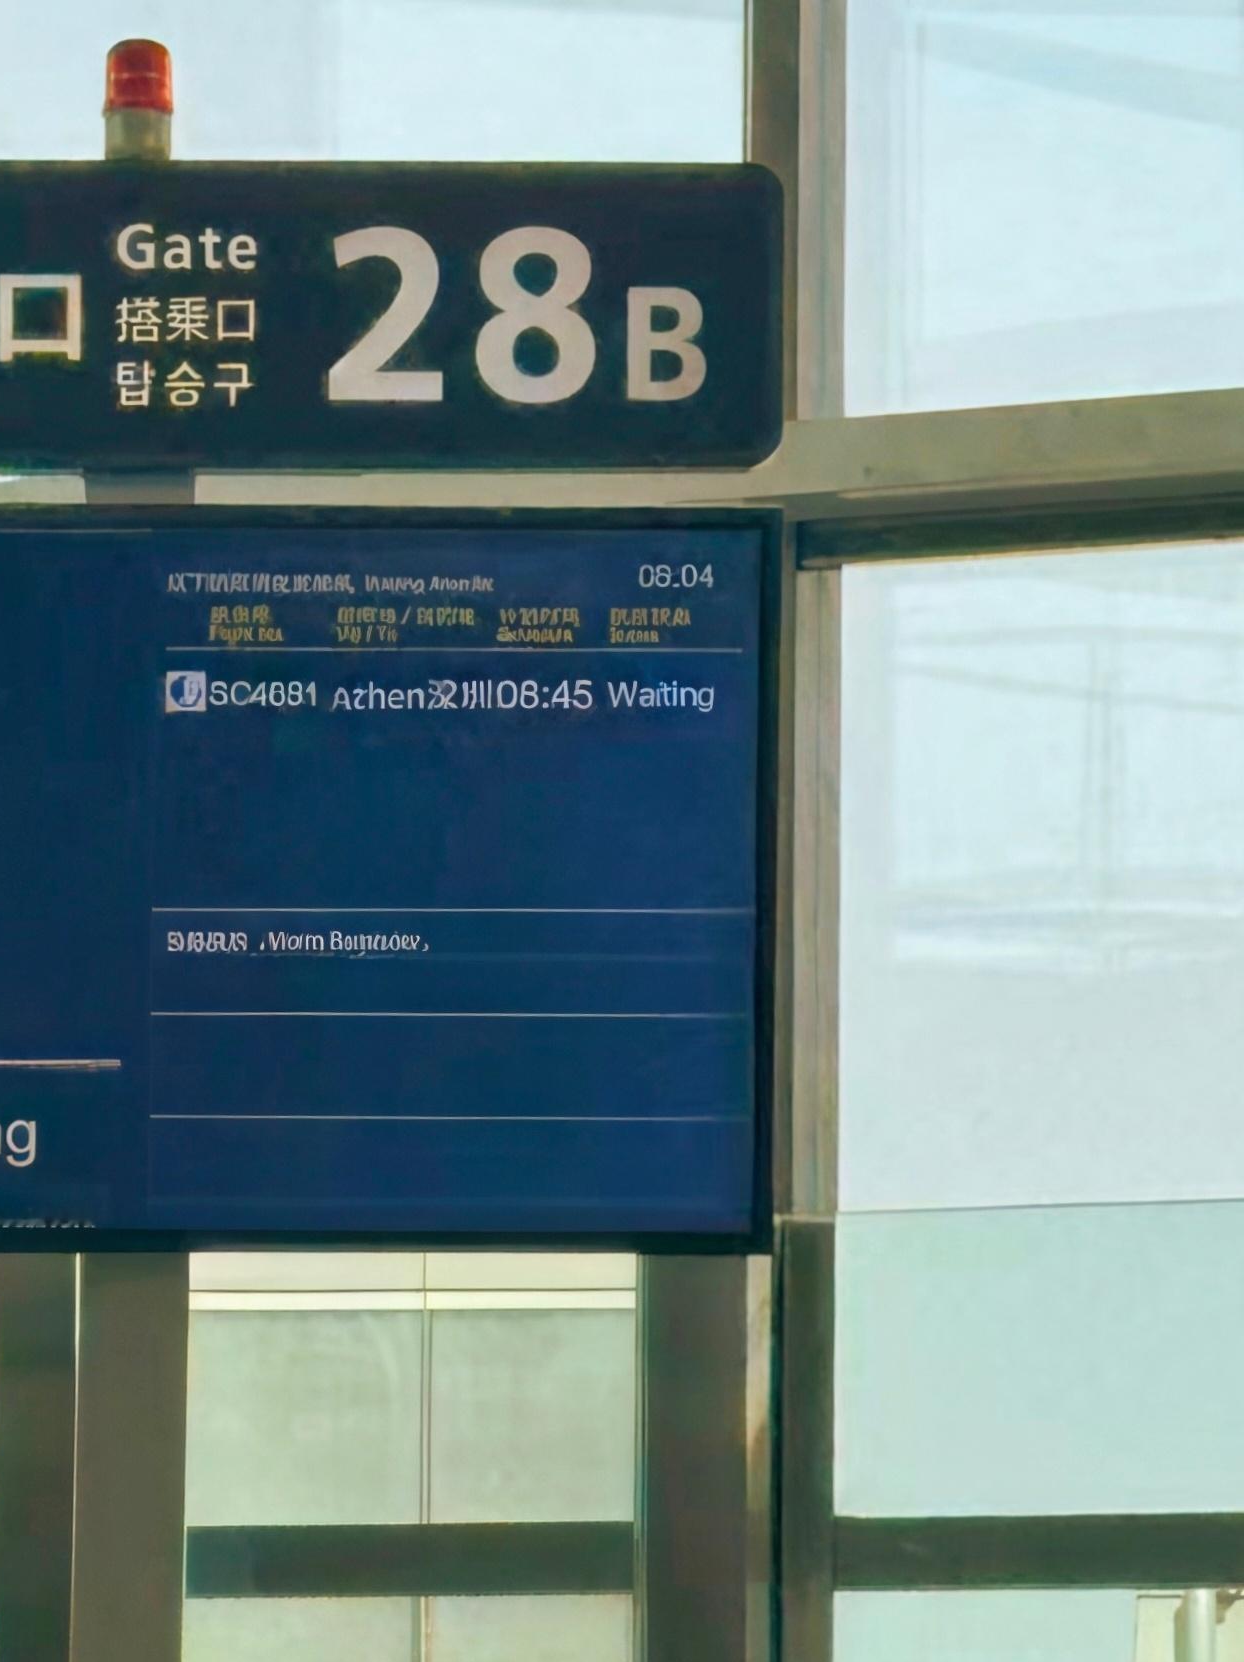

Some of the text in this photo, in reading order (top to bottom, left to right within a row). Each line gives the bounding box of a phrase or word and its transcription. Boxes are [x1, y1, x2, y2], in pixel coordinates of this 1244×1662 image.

[116, 223, 258, 270] Gate
[116, 360, 255, 407] 탑승구
[497, 679, 594, 710] 08:45
[607, 680, 716, 712] Waiting
